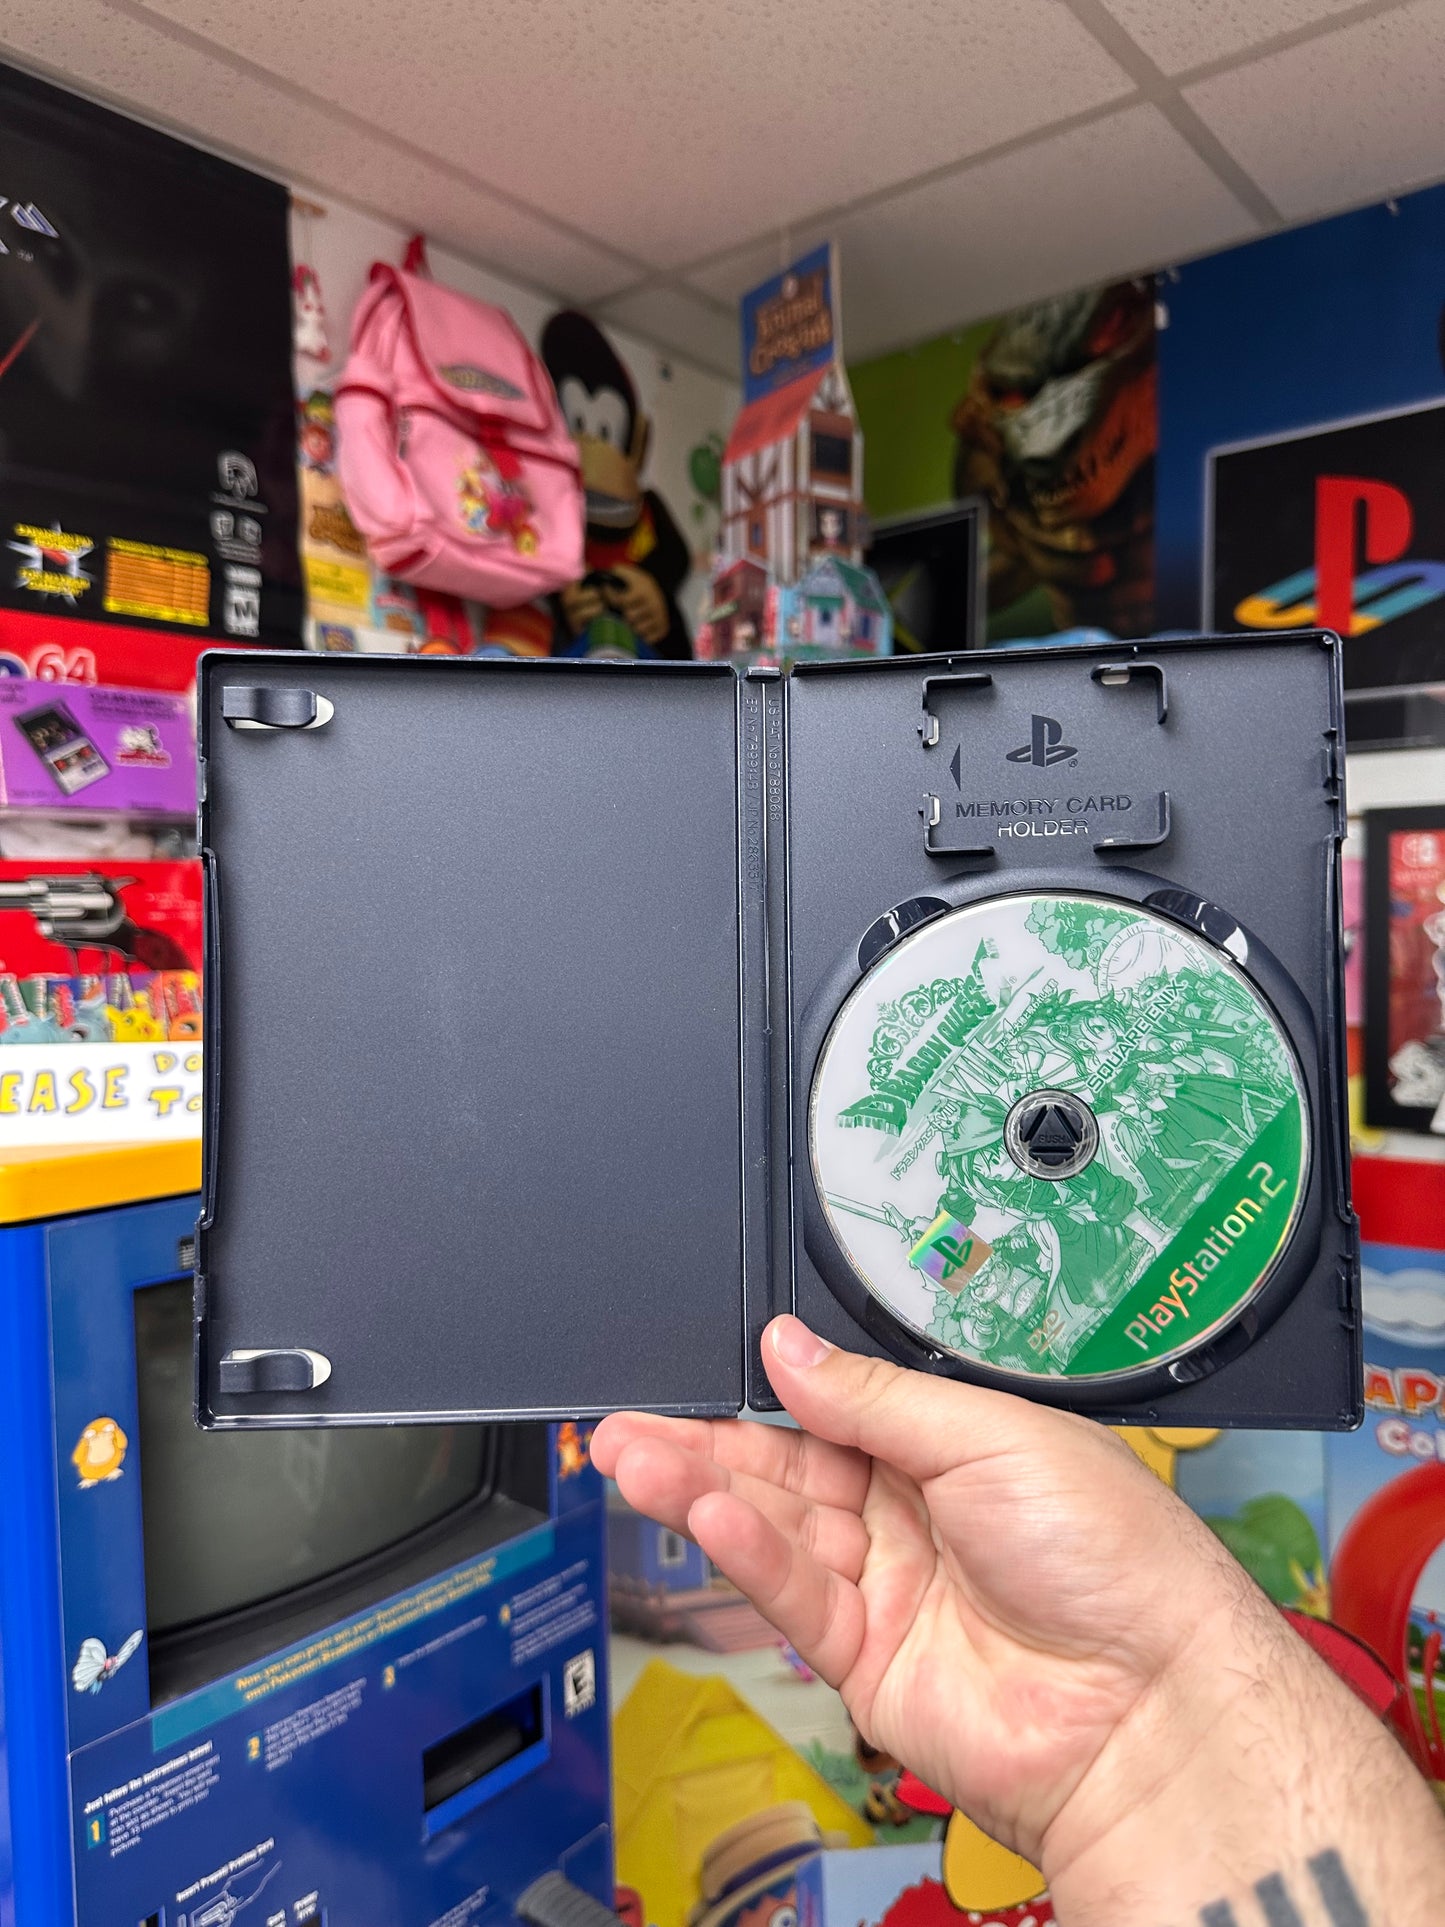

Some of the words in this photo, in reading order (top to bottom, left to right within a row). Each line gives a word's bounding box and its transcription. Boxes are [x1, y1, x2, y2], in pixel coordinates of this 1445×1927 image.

[769, 699, 780, 716] US
[769, 720, 780, 741] PAT
[769, 745, 780, 759] No
[769, 761, 781, 822] 5788068
[955, 799, 1059, 818] MEMORY
[1066, 794, 1132, 814] CARD
[747, 803, 759, 817] JP
[747, 820, 759, 835] No
[997, 818, 1088, 838] HOLDER
[747, 838, 759, 893] 2863317
[1087, 1019, 1151, 1093] SQUARE
[1145, 978, 1186, 1021] ENIX
[836, 1034, 951, 1137] DRAGON
[930, 1036, 1015, 1109] VIII
[1124, 1197, 1263, 1350] PlayStation
[1248, 1161, 1287, 1198] 2
[1028, 1309, 1060, 1350] DVD
[1363, 1363, 1445, 1417] AP
[91, 1820, 100, 1842] 1
